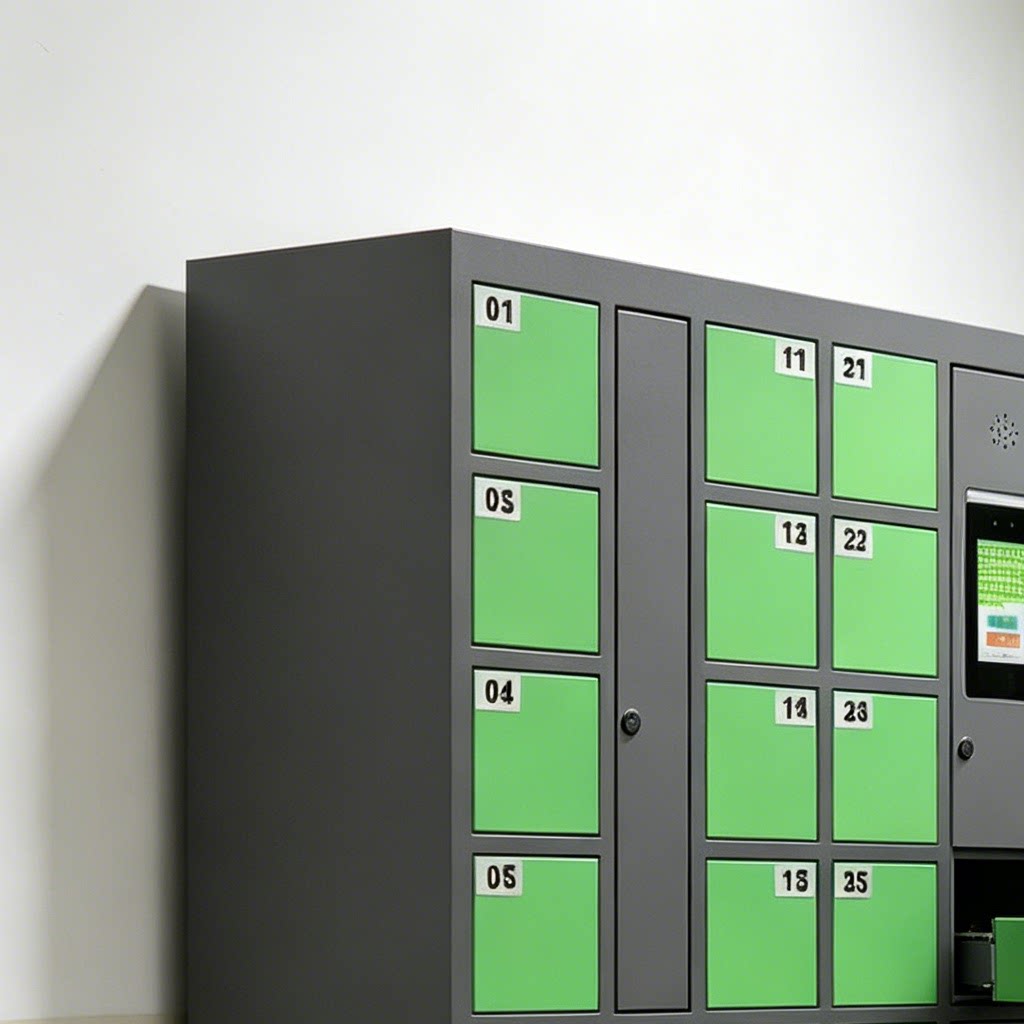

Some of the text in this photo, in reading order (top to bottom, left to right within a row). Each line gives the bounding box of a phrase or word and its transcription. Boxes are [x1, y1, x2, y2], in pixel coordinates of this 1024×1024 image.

[486, 295, 513, 324] 01
[783, 346, 806, 372] 11
[843, 356, 865, 381] 21
[843, 527, 867, 552] 22
[485, 679, 514, 705] 04
